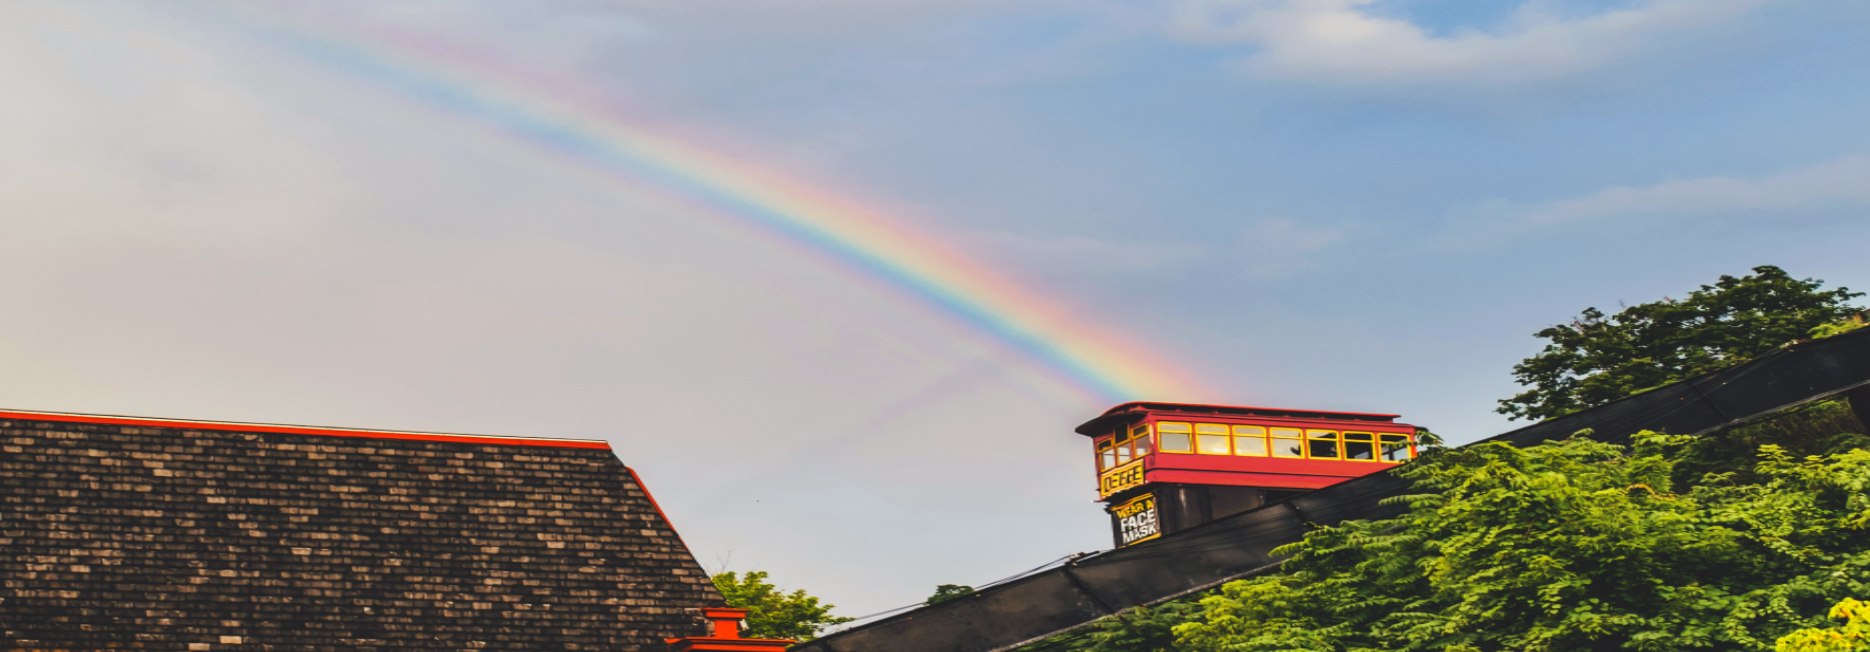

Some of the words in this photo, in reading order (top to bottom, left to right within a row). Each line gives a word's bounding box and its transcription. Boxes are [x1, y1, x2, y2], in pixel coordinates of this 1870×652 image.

[1117, 502, 1144, 519] WEAR
[1146, 499, 1154, 510] A
[1120, 508, 1156, 532] FACE
[1122, 522, 1156, 543] MASK
